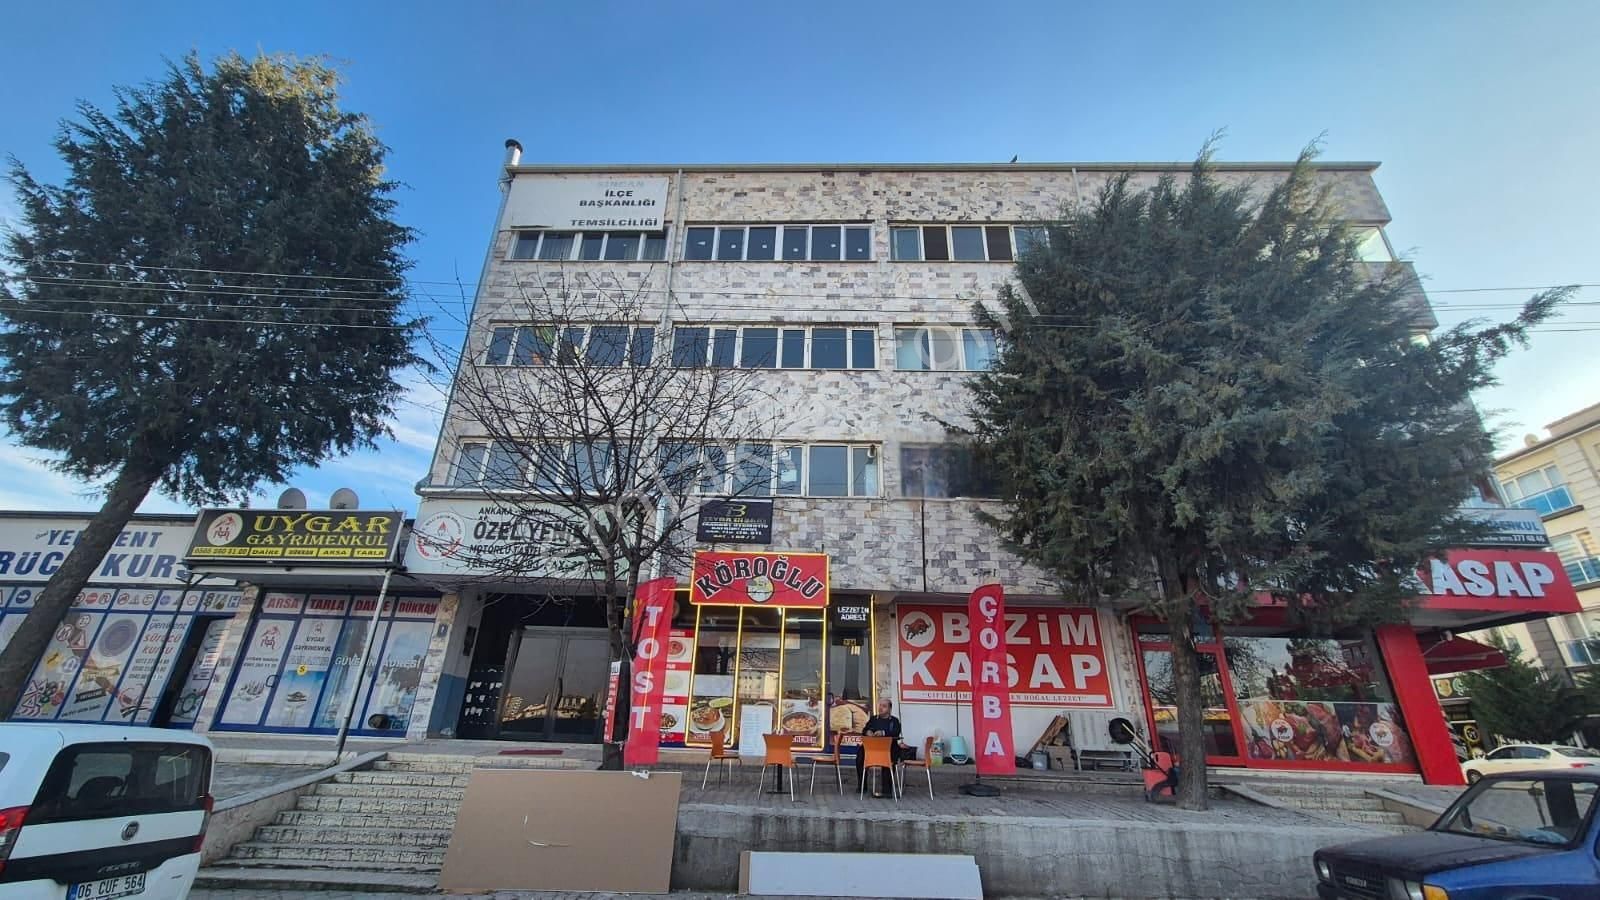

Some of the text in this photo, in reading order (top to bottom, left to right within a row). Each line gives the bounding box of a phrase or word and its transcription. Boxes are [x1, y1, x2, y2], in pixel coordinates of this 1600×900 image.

[605, 189, 633, 198] İLÇE
[579, 199, 655, 208] BAŞKANLIĞI
[570, 217, 658, 227] TEMSİLCİLİĞİ
[253, 513, 393, 534] UYGAR
[474, 516, 521, 541] ÖZEL
[47, 530, 163, 548] YEENT
[246, 533, 389, 546] GAYRİMENKUL
[696, 556, 824, 599] KÖROĞLU
[267, 598, 301, 609] ARSA
[310, 598, 346, 610] TARLA
[355, 600, 391, 611] DAİE
[399, 601, 437, 614] DÜKKAN
[942, 611, 1098, 646] BZİM
[335, 655, 375, 667] GÜVEİN
[632, 606, 664, 729] TOST
[979, 596, 1005, 756] ÇORBA
[77, 874, 144, 899] 06 CUF 564
